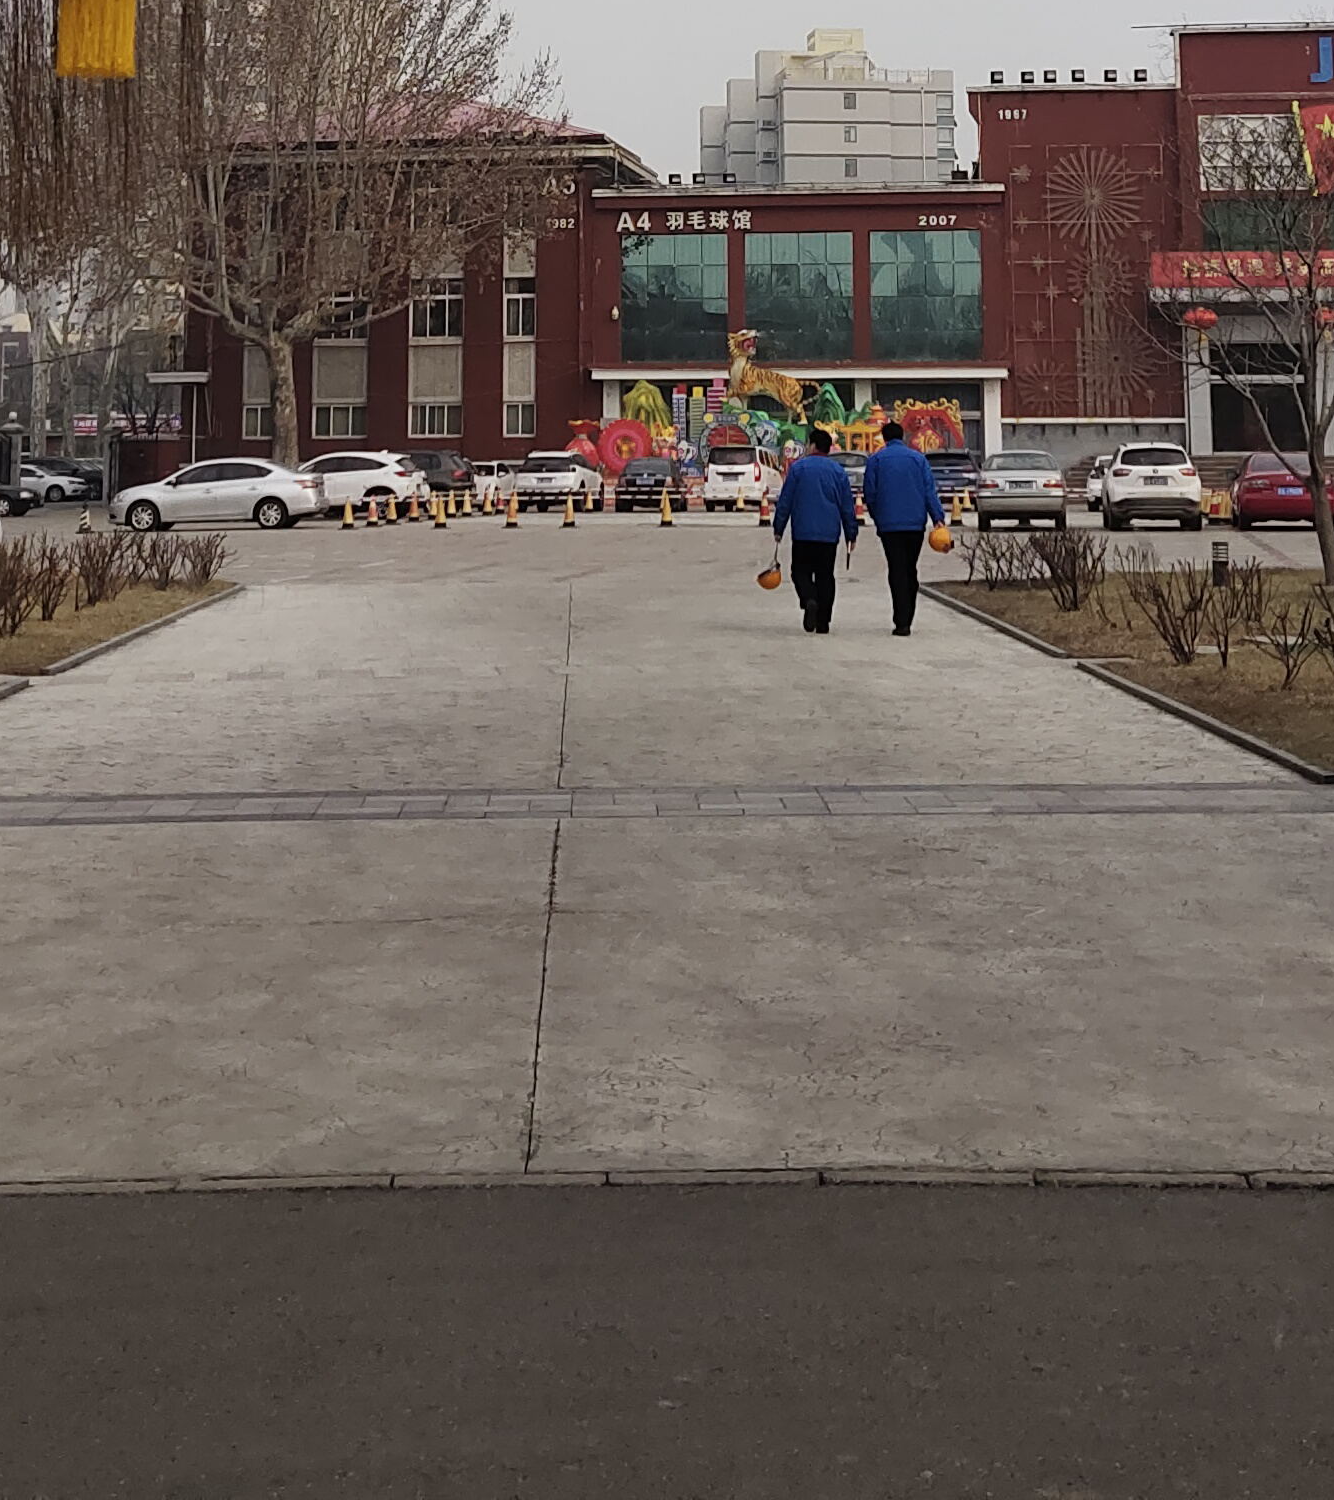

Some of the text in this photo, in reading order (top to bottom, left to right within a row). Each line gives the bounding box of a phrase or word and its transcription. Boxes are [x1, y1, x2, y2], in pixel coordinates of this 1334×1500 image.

[616, 209, 752, 233] A4 羽毛球馆
[918, 214, 957, 226] 2007
